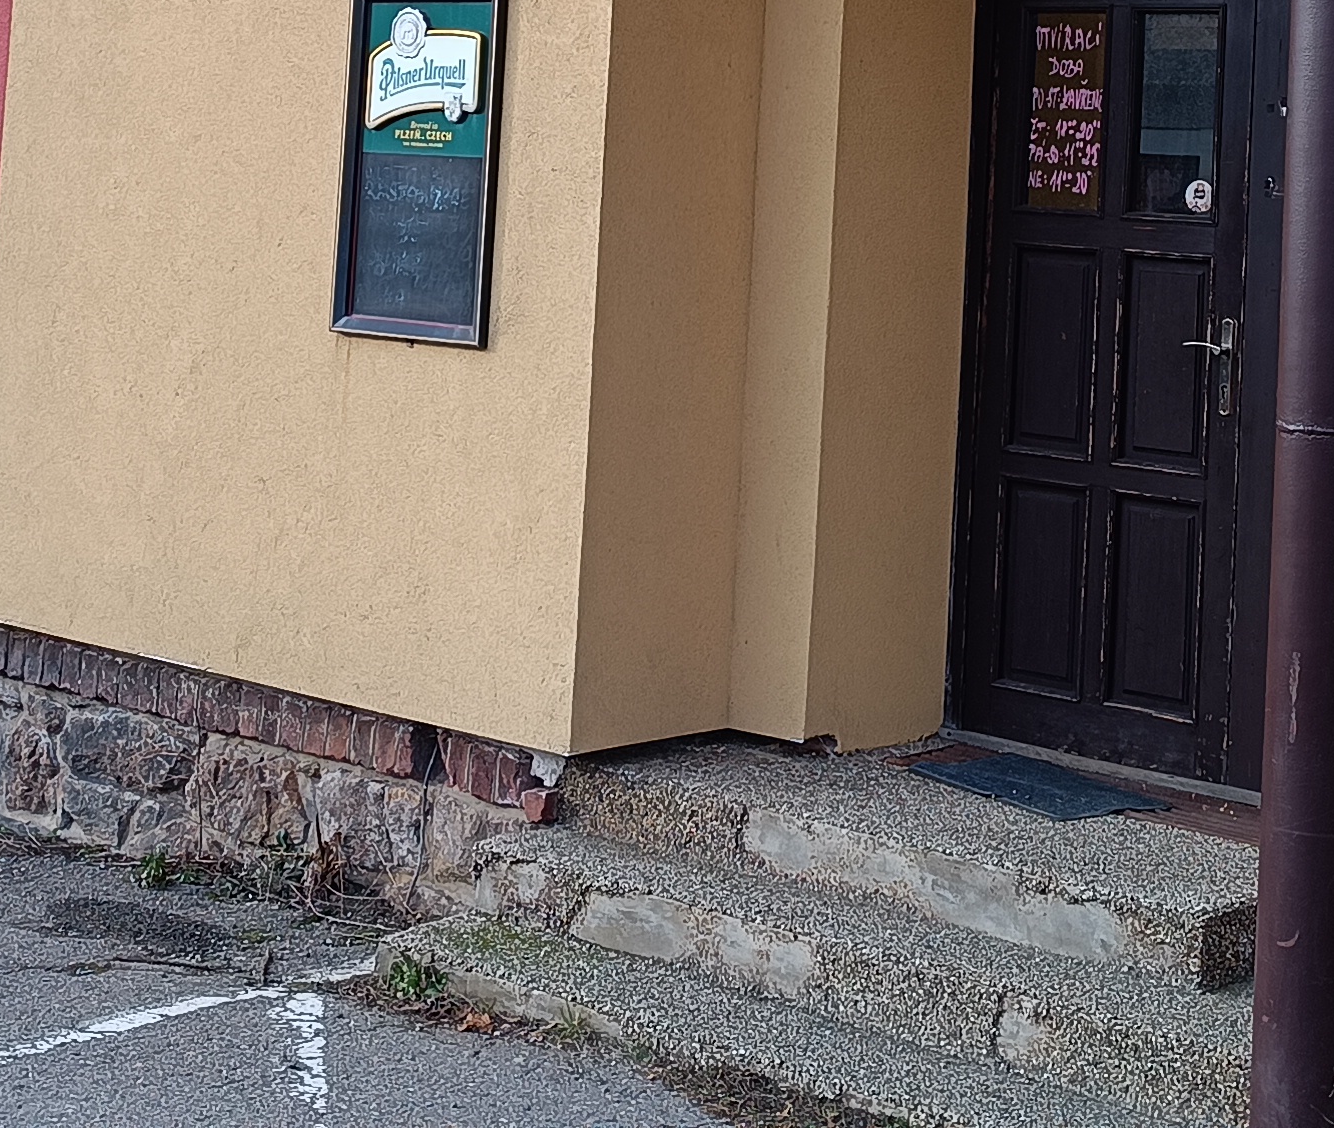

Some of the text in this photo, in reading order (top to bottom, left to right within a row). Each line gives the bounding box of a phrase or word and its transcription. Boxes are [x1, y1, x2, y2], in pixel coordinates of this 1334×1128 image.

[379, 56, 466, 101] Pilsner Urquell
[1048, 56, 1083, 77] DOBA
